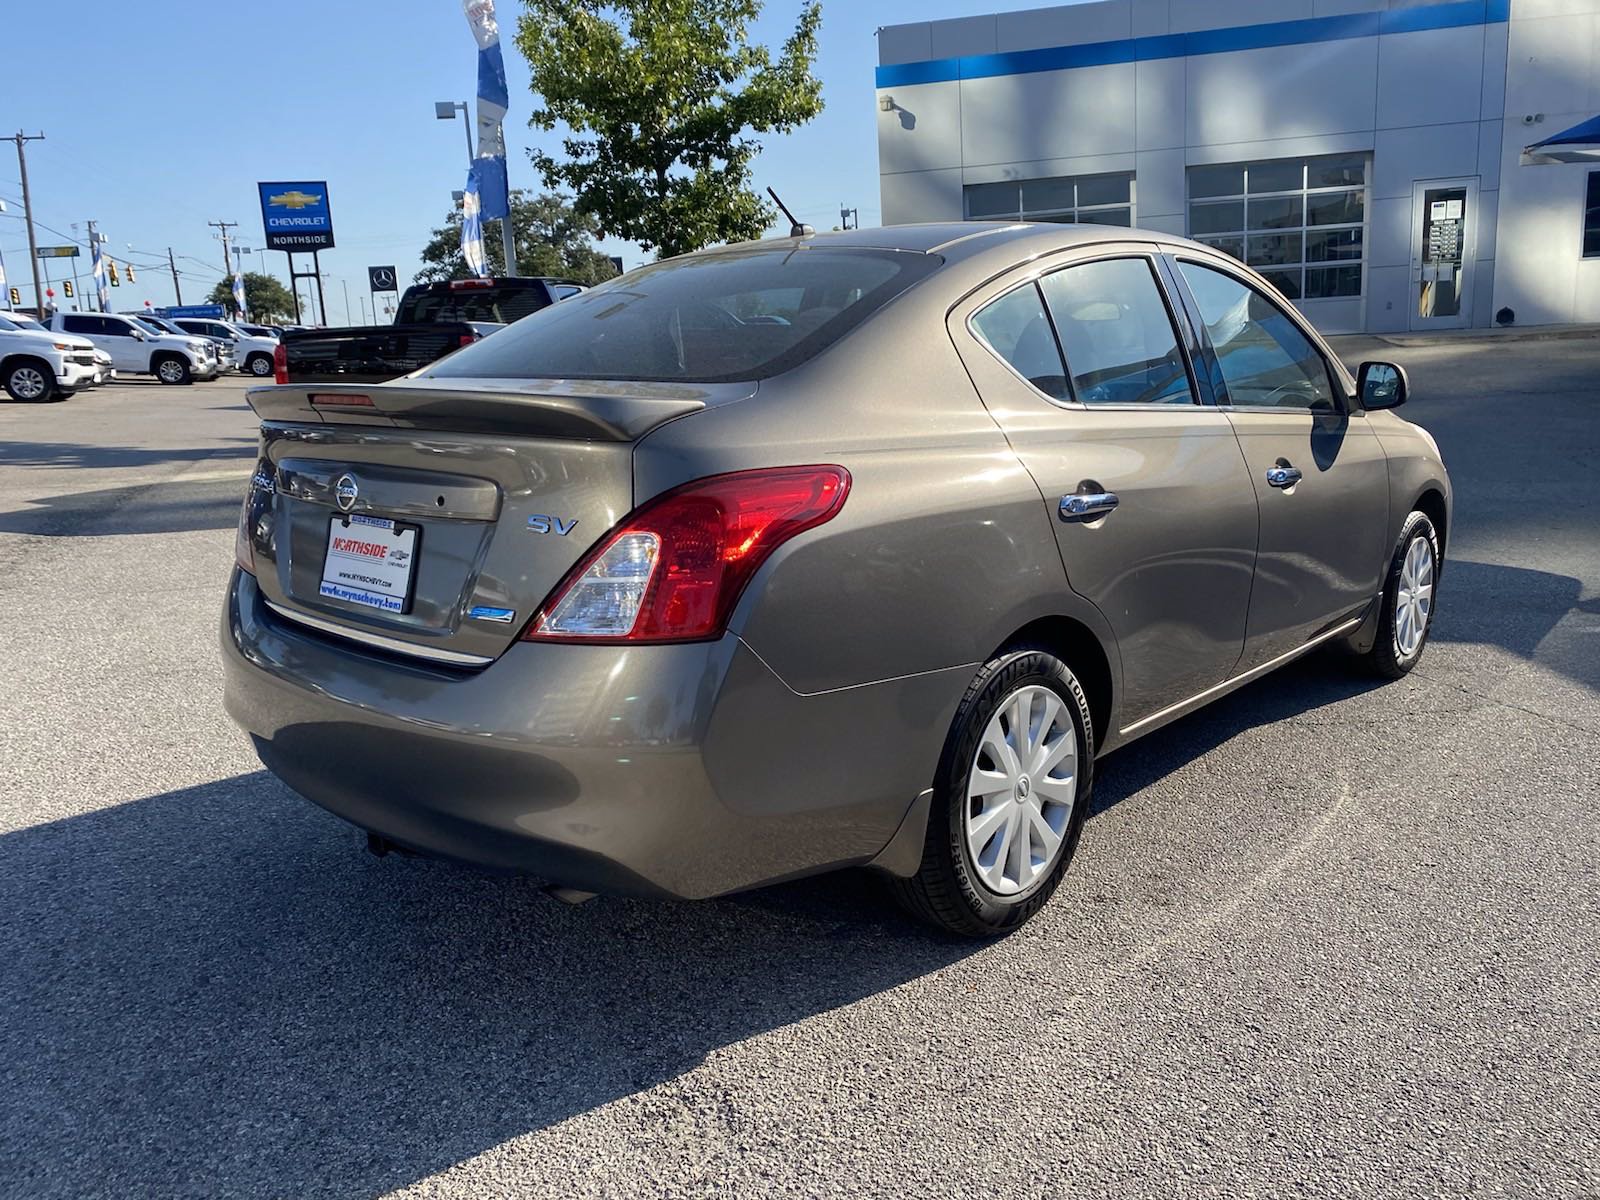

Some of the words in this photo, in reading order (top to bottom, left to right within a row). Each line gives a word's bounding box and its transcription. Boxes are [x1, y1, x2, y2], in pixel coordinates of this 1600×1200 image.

[269, 217, 325, 226] CHEVROLET
[273, 236, 327, 245] NORTHSIDE
[526, 514, 577, 536] SV
[333, 537, 388, 559] NORTHSIDE
